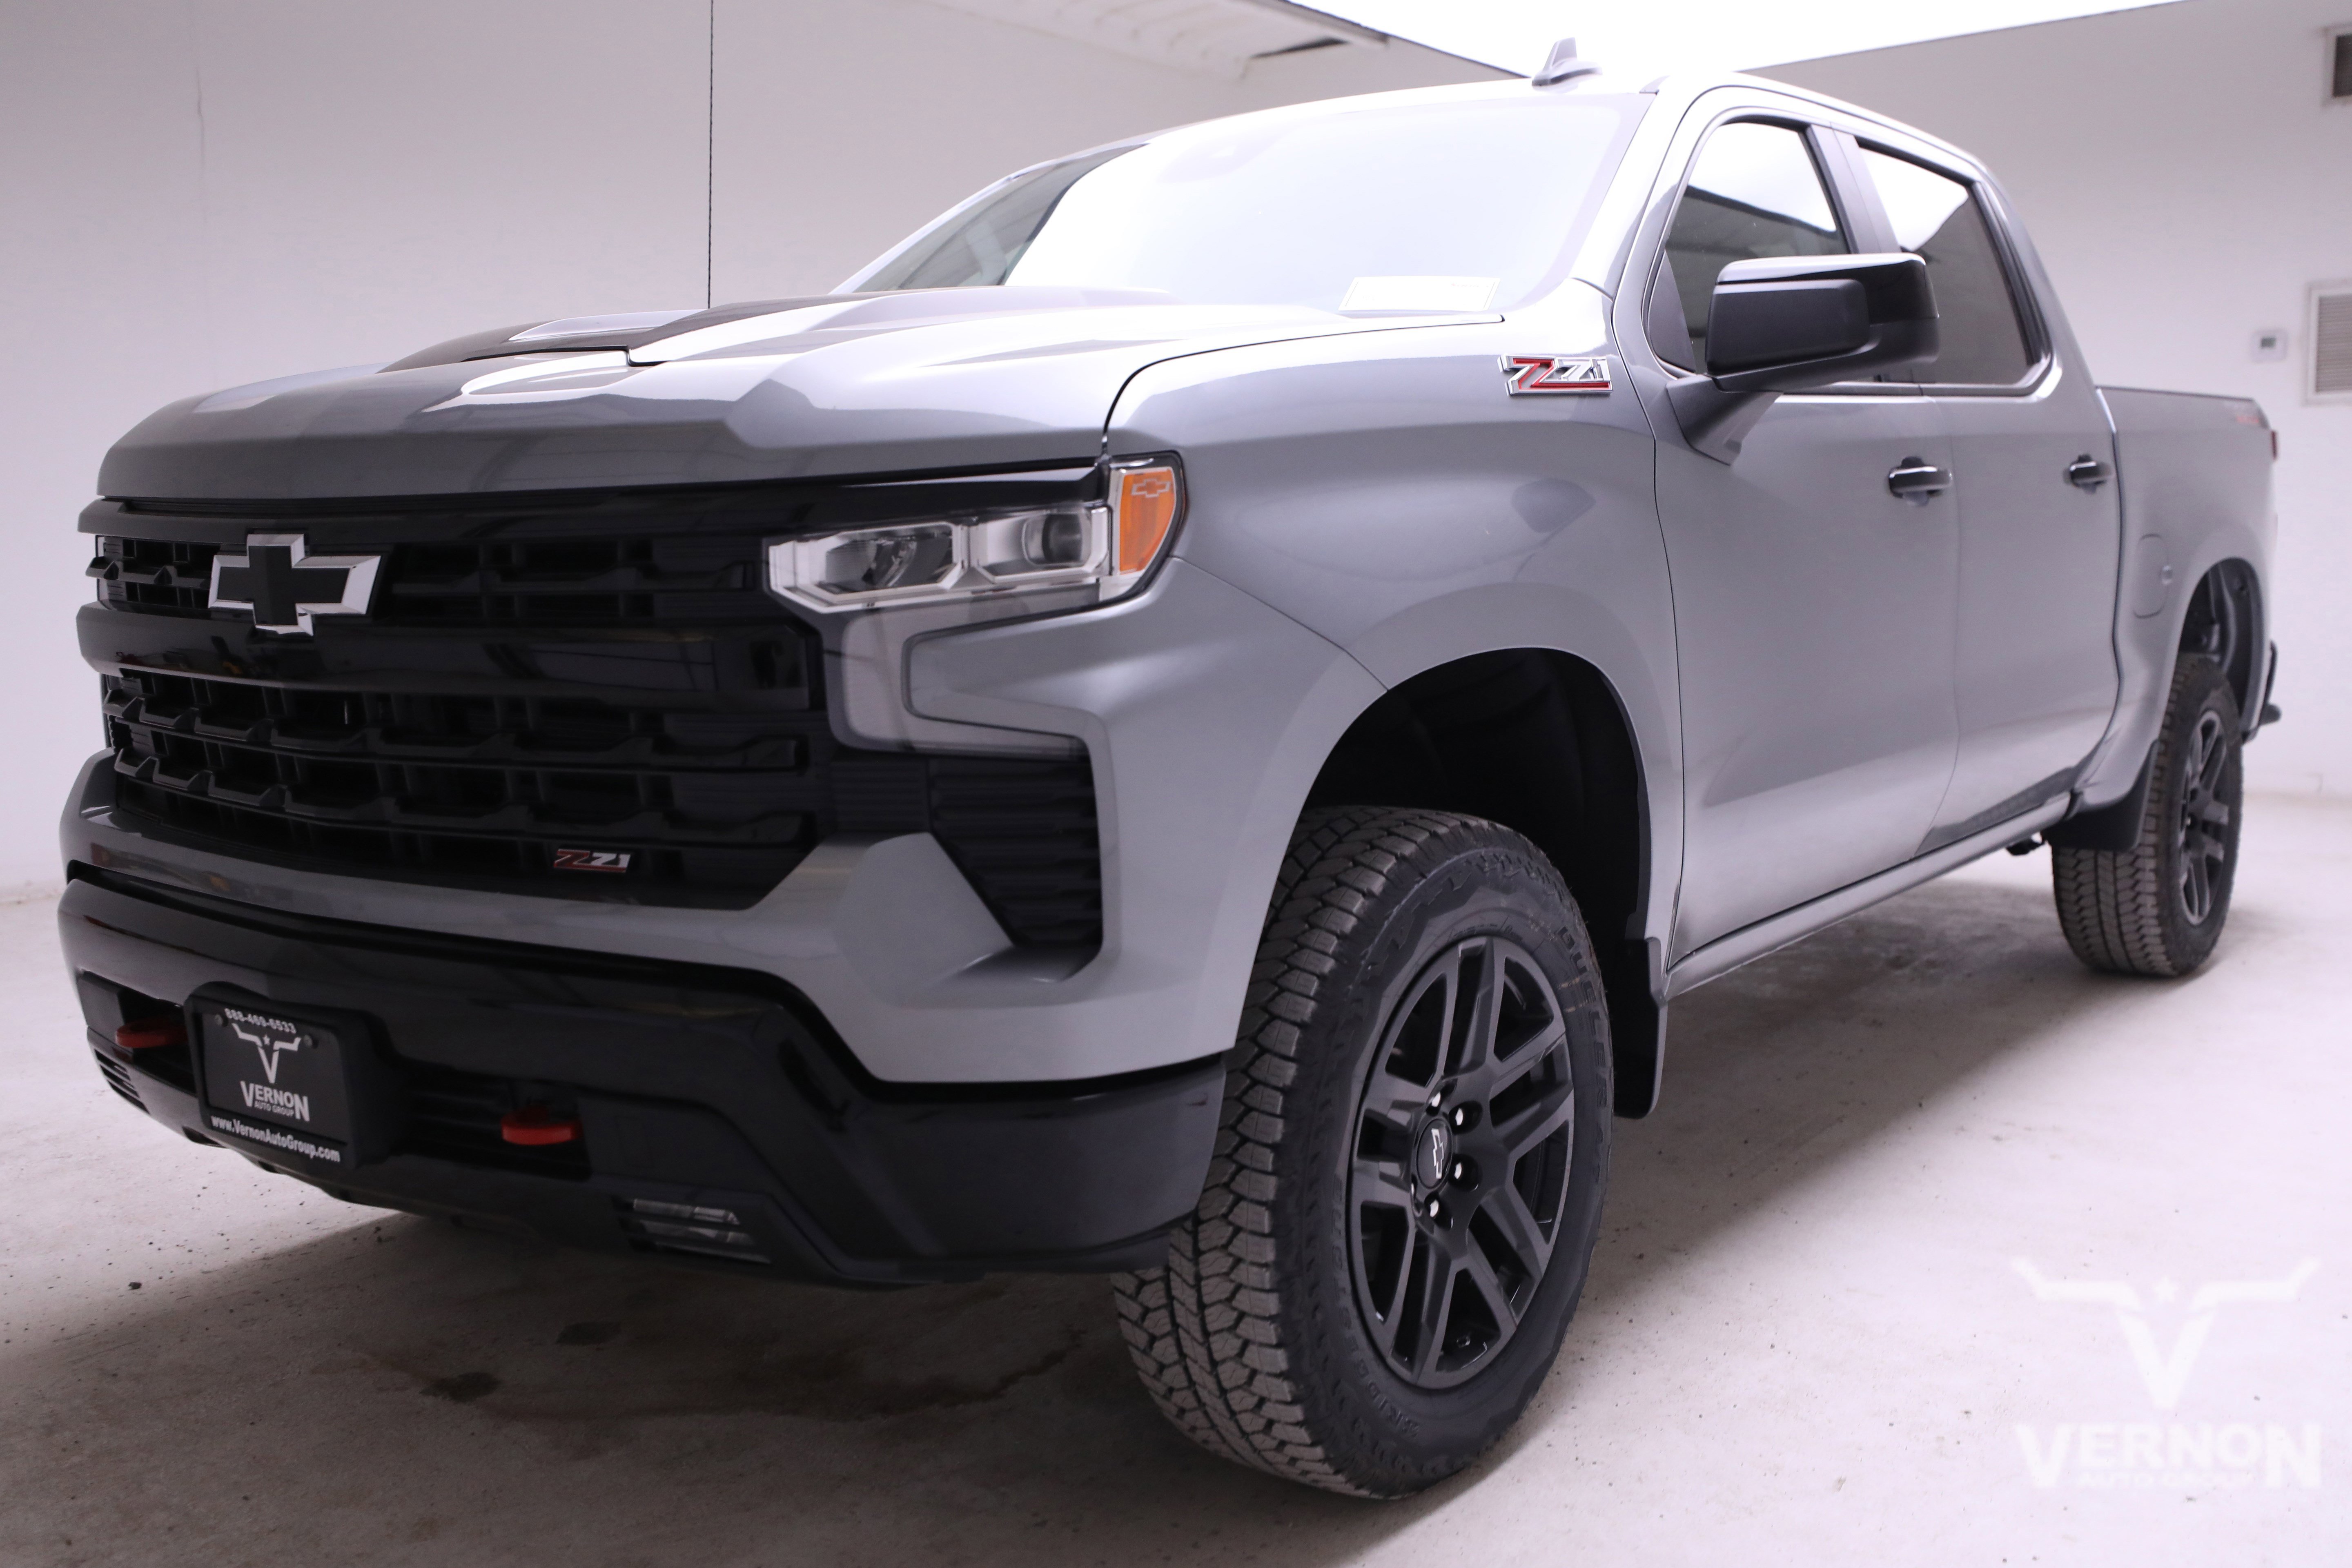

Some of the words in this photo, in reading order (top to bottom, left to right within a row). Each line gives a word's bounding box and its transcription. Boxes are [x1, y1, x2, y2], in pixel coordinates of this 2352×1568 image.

[1497, 354, 1613, 395] Z71
[553, 849, 631, 873] Z71
[240, 1080, 310, 1122] VERNON
[254, 1100, 272, 1111] AUTO
[272, 1105, 295, 1117] GROUP
[210, 1115, 341, 1163] www.VernonAutoGroup.com
